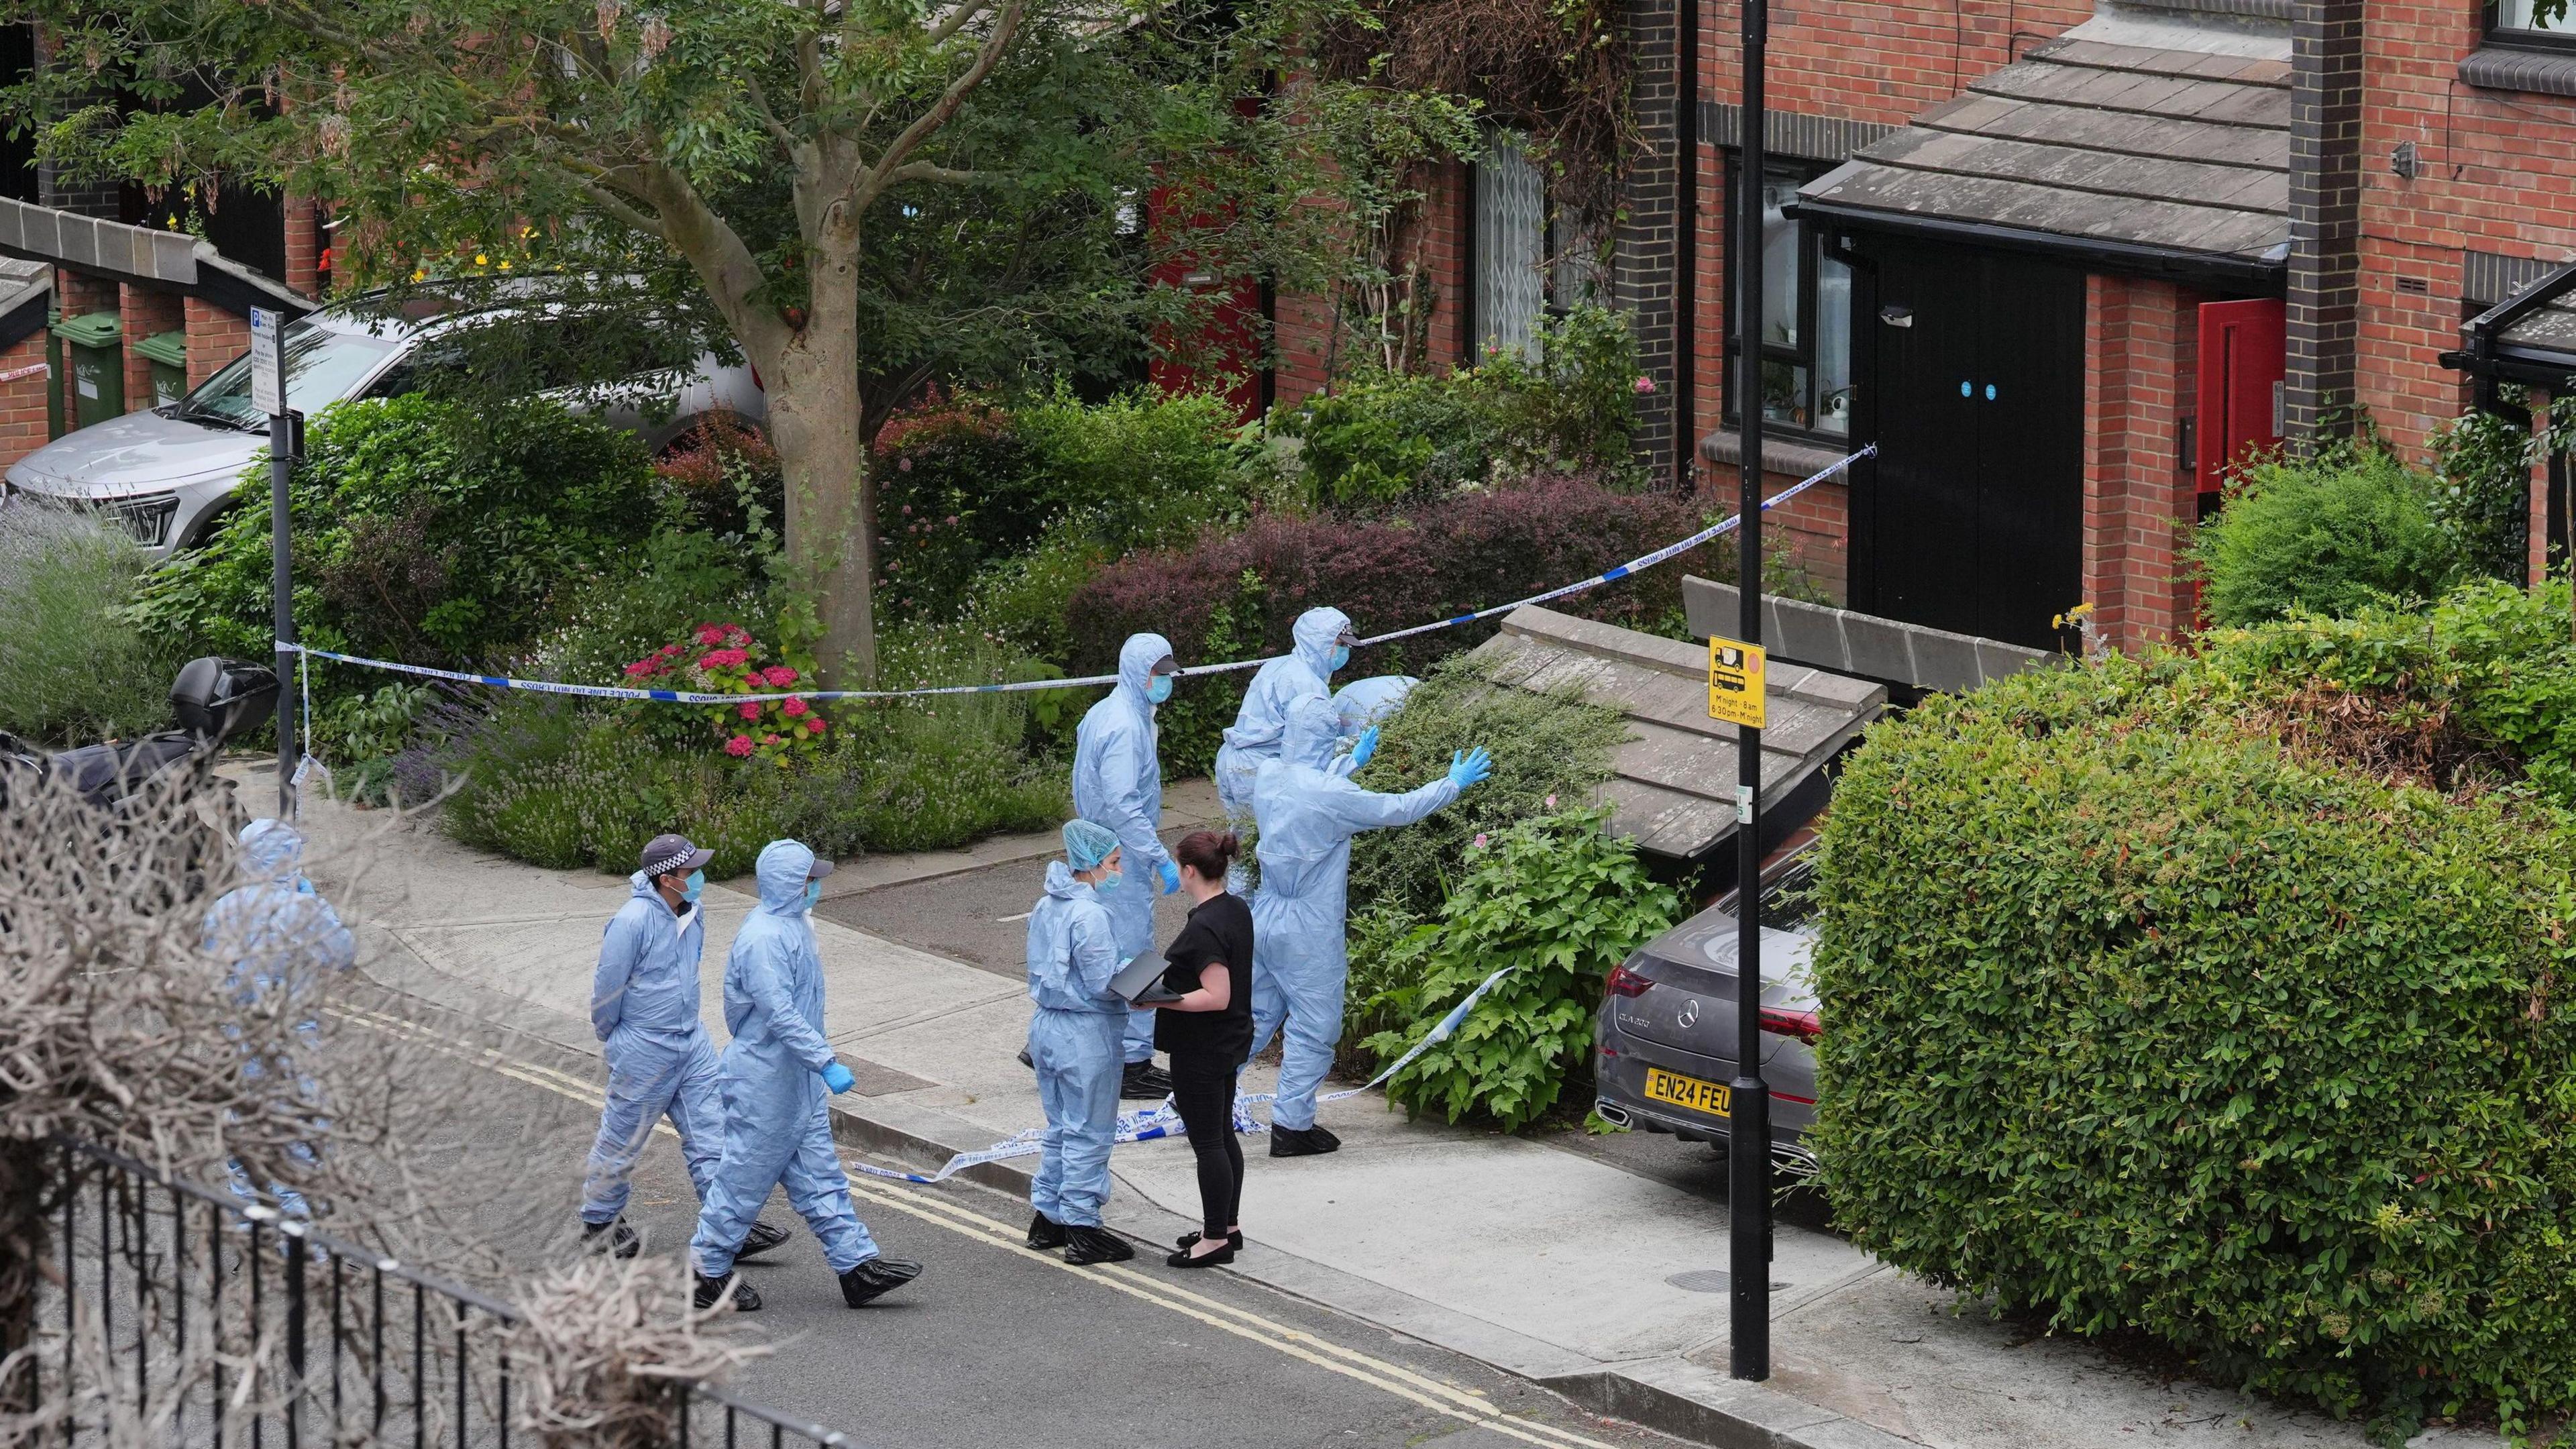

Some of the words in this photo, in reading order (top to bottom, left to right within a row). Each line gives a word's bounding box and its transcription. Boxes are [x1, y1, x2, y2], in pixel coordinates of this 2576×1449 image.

[254, 311, 258, 325] P
[1637, 553, 1664, 568] CROSS
[521, 682, 550, 691] CROSS
[1656, 1073, 1696, 1104] EN24
